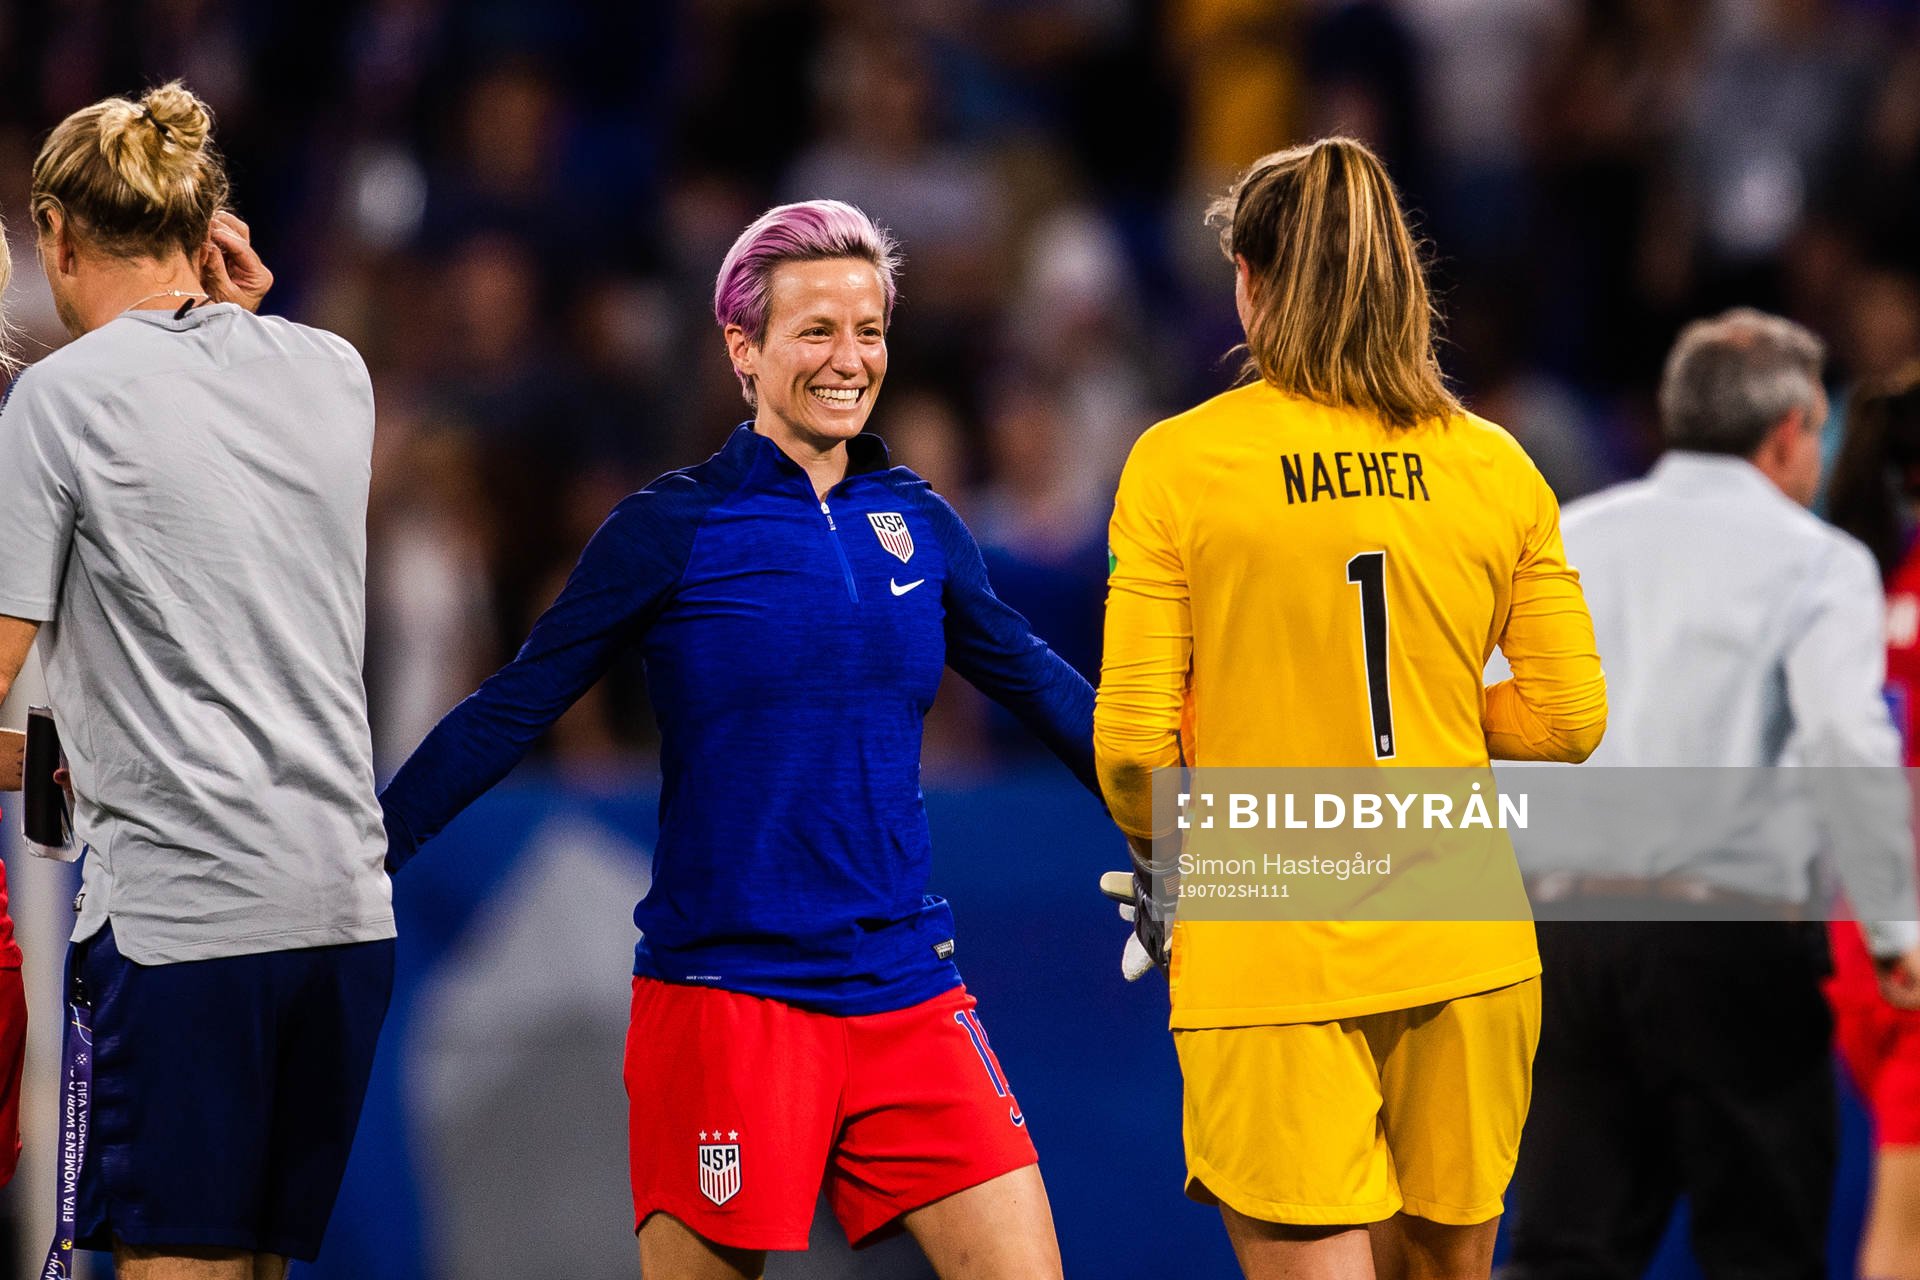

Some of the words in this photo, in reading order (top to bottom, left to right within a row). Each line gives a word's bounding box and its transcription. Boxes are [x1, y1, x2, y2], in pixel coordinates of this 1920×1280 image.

[1280, 451, 1430, 505] NAEHER
[871, 515, 905, 533] USA
[1347, 550, 1396, 761] 1
[954, 1009, 1014, 1097] 1
[77, 1081, 88, 1107] FIFA
[64, 1131, 77, 1195] WOMEN'S
[701, 1148, 736, 1171] USA
[62, 1196, 75, 1222] FIFA
